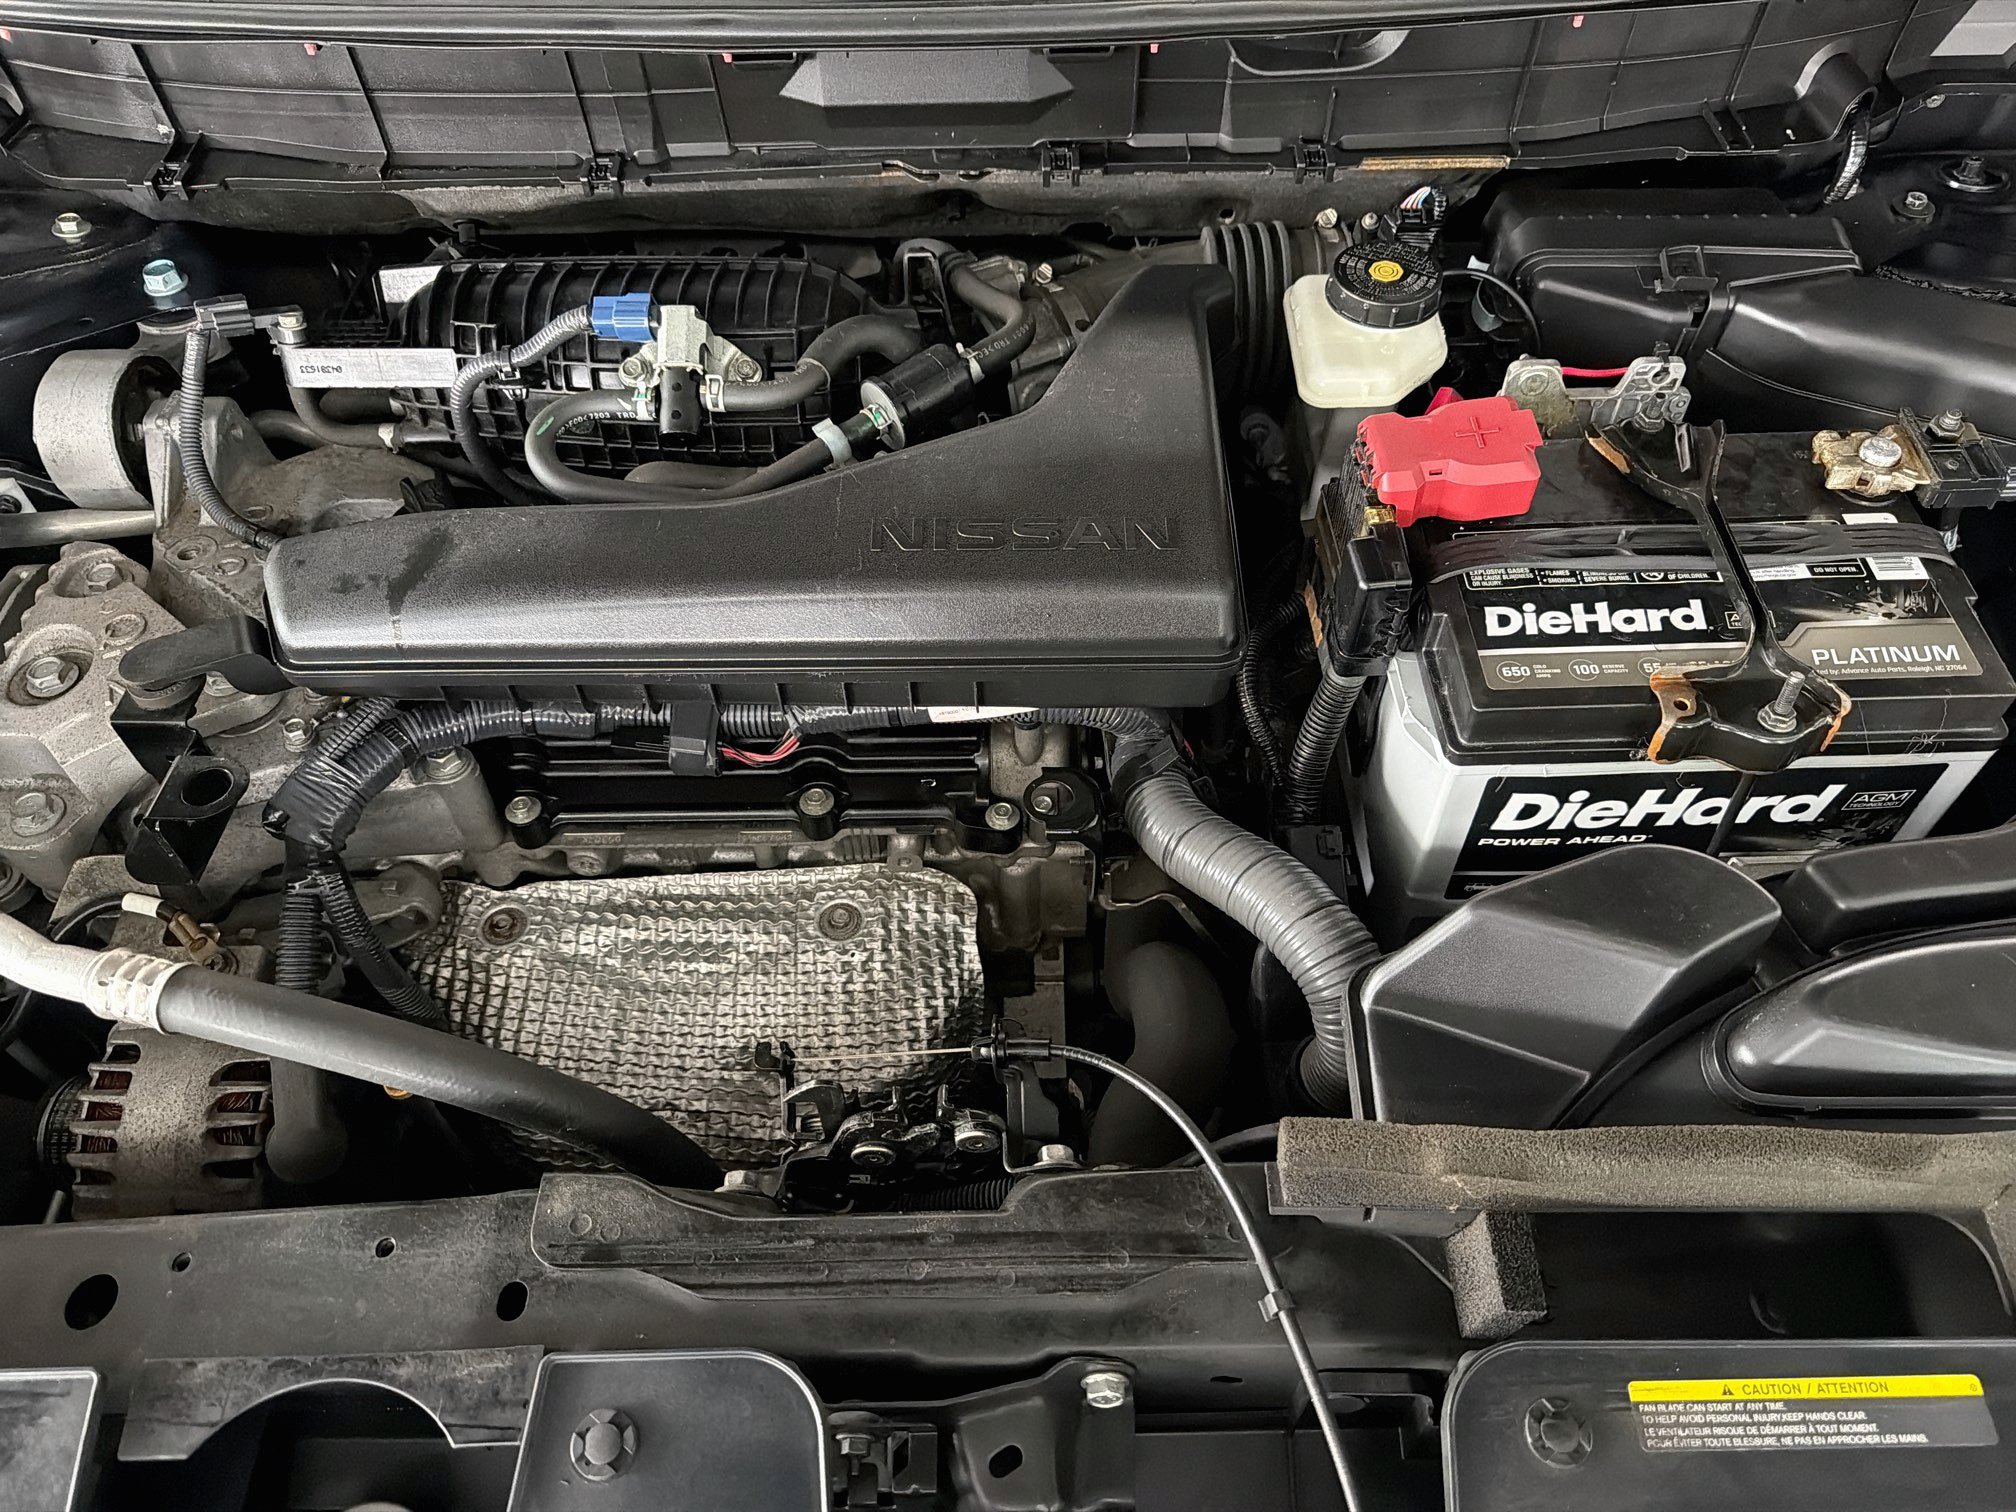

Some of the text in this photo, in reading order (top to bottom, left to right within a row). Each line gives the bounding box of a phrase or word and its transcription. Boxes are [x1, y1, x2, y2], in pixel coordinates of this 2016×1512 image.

[871, 516, 1179, 551] NISSAN
[1469, 568, 1506, 576] EXPLOSIVE
[1502, 572, 1534, 580] BLINDNESS
[1484, 599, 1708, 637] DieHard
[1811, 644, 1961, 666] PLATINUM
[1501, 666, 1531, 677] 650
[1573, 664, 1600, 675] 100
[1853, 792, 1909, 803] AGM
[1490, 784, 1848, 831] DieHard
[1478, 834, 1648, 846] POWER AHEAD
[1742, 1383, 1801, 1395] CAUTION
[1817, 1381, 1890, 1394] ATTENTION
[1639, 1404, 1656, 1412] FAN
[1657, 1403, 1685, 1412] BLADE
[1686, 1403, 1705, 1412] CAN
[1706, 1402, 1733, 1412] START
[1734, 1402, 1744, 1411] AT
[1746, 1402, 1763, 1411] ANY
[1642, 1415, 1654, 1424] TO
[1655, 1414, 1677, 1424] HELP
[1679, 1414, 1705, 1423] AVOID
[1706, 1413, 1752, 1423] PERSONAL
[1805, 1411, 1836, 1421] HANDS
[1837, 1411, 1868, 1420] CLEAR.
[1644, 1422, 1880, 1436] LE VENTILATEUR RISQUE DE DÉMARRER À TOUT MOMENT.
[1646, 1433, 1929, 1448] POUR ÉVITER TOUTE BLESSURE, NE PAS EN APPROCHER LES MAINS.
